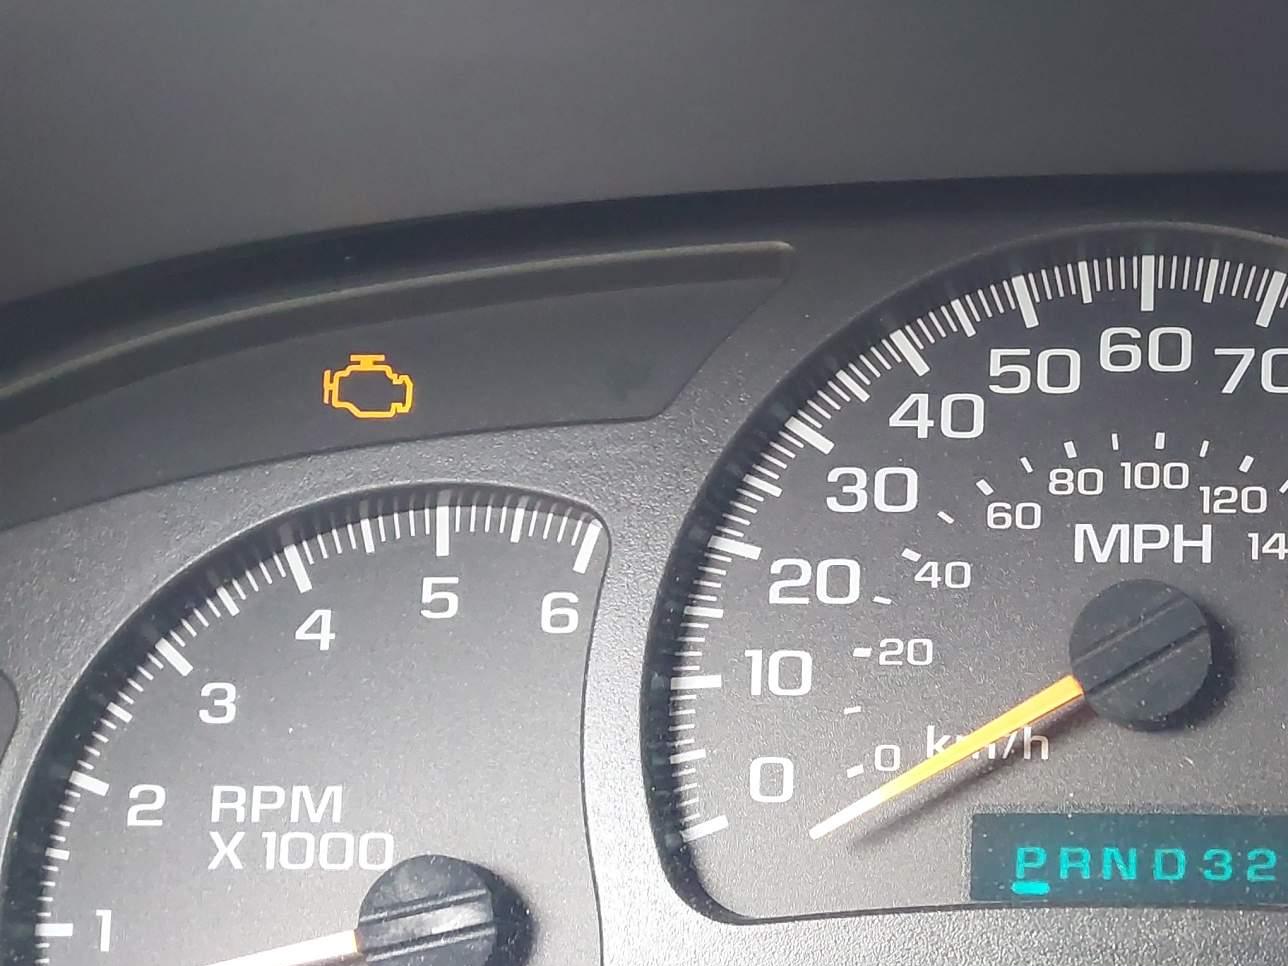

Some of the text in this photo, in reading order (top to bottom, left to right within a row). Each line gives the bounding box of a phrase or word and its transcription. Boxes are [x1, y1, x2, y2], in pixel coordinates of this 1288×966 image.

[1099, 326, 1193, 373] 60
[988, 348, 1081, 394] 50
[888, 393, 985, 439] 40
[826, 466, 919, 513] 30
[1048, 468, 1104, 496] 80
[1120, 461, 1190, 490] 100
[986, 502, 1041, 530] 60
[1199, 486, 1267, 514] 120
[1074, 523, 1213, 564] MPH
[768, 558, 861, 605] 20
[914, 561, 971, 589] 40
[420, 576, 459, 619] 5
[540, 592, 579, 635] 6
[295, 609, 336, 651] 4
[744, 649, 813, 696] 10
[878, 638, 934, 666] 20
[199, 682, 238, 724] 3
[874, 744, 901, 771] 0
[926, 724, 1049, 760] k/h
[749, 756, 794, 803] 0
[126, 785, 166, 827] 2
[210, 785, 343, 824] RPM
[208, 832, 395, 870] X 1000
[96, 909, 111, 952] 1
